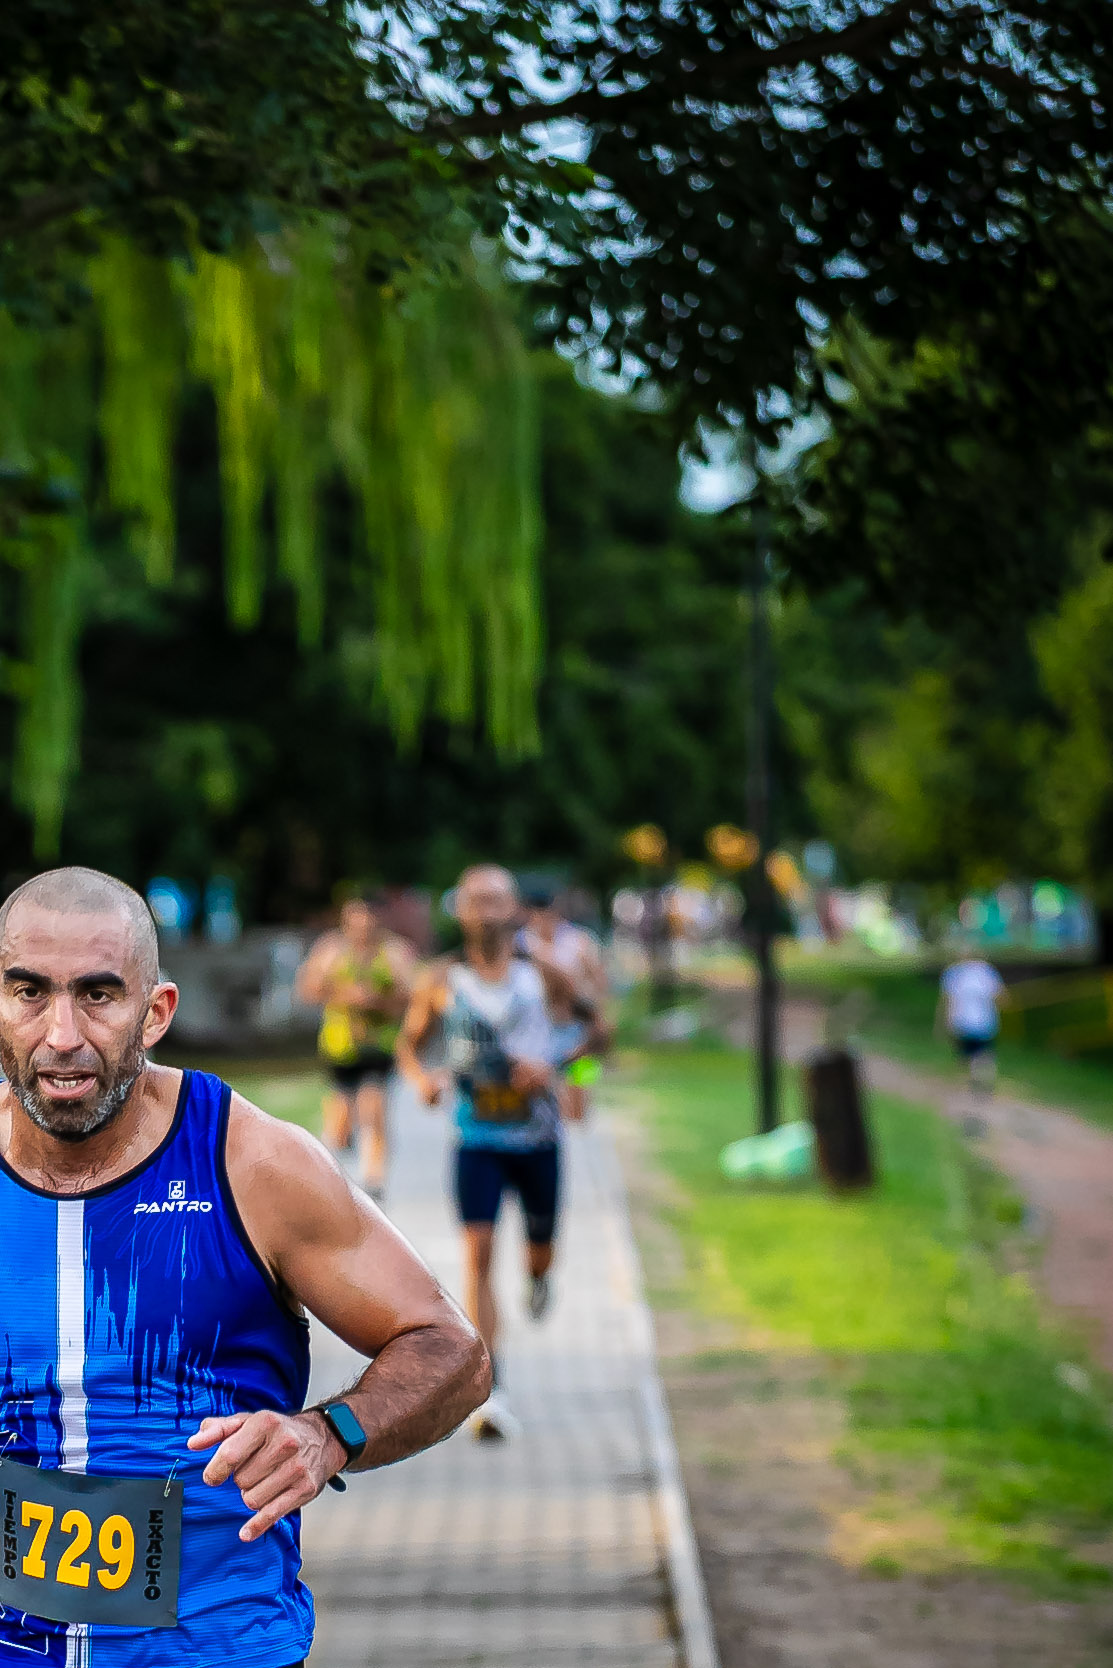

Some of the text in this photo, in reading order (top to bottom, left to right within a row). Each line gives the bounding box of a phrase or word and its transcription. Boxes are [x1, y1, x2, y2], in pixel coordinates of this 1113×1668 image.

[133, 1200, 213, 1215] PANTRO
[3, 1488, 18, 1580] TIEMPO
[20, 1500, 135, 1591] 729
[143, 1509, 164, 1601] EXACTO
